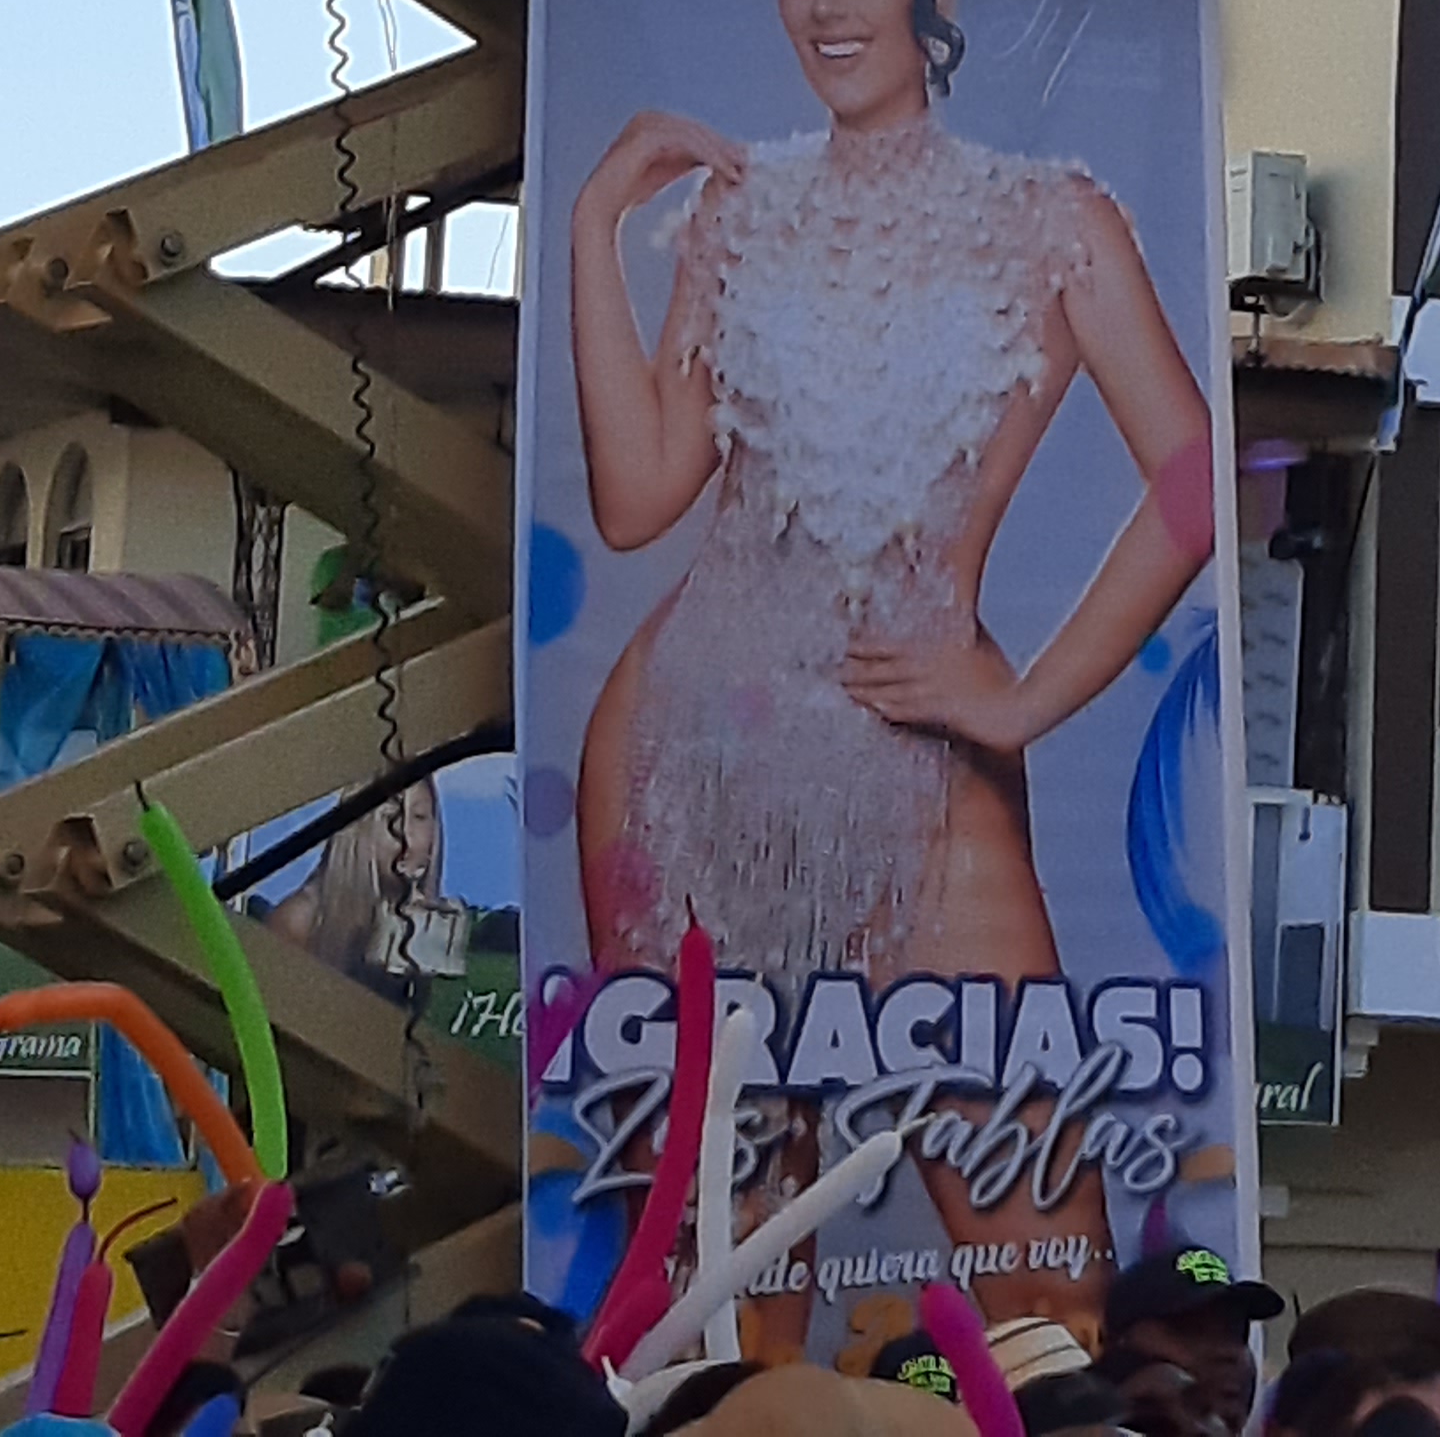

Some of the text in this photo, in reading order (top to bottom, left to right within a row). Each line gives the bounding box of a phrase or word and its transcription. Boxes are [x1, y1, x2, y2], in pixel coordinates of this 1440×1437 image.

[834, 1039, 1202, 1212] Tablas
[817, 1246, 940, 1304] quiera
[951, 1241, 1020, 1292] que
